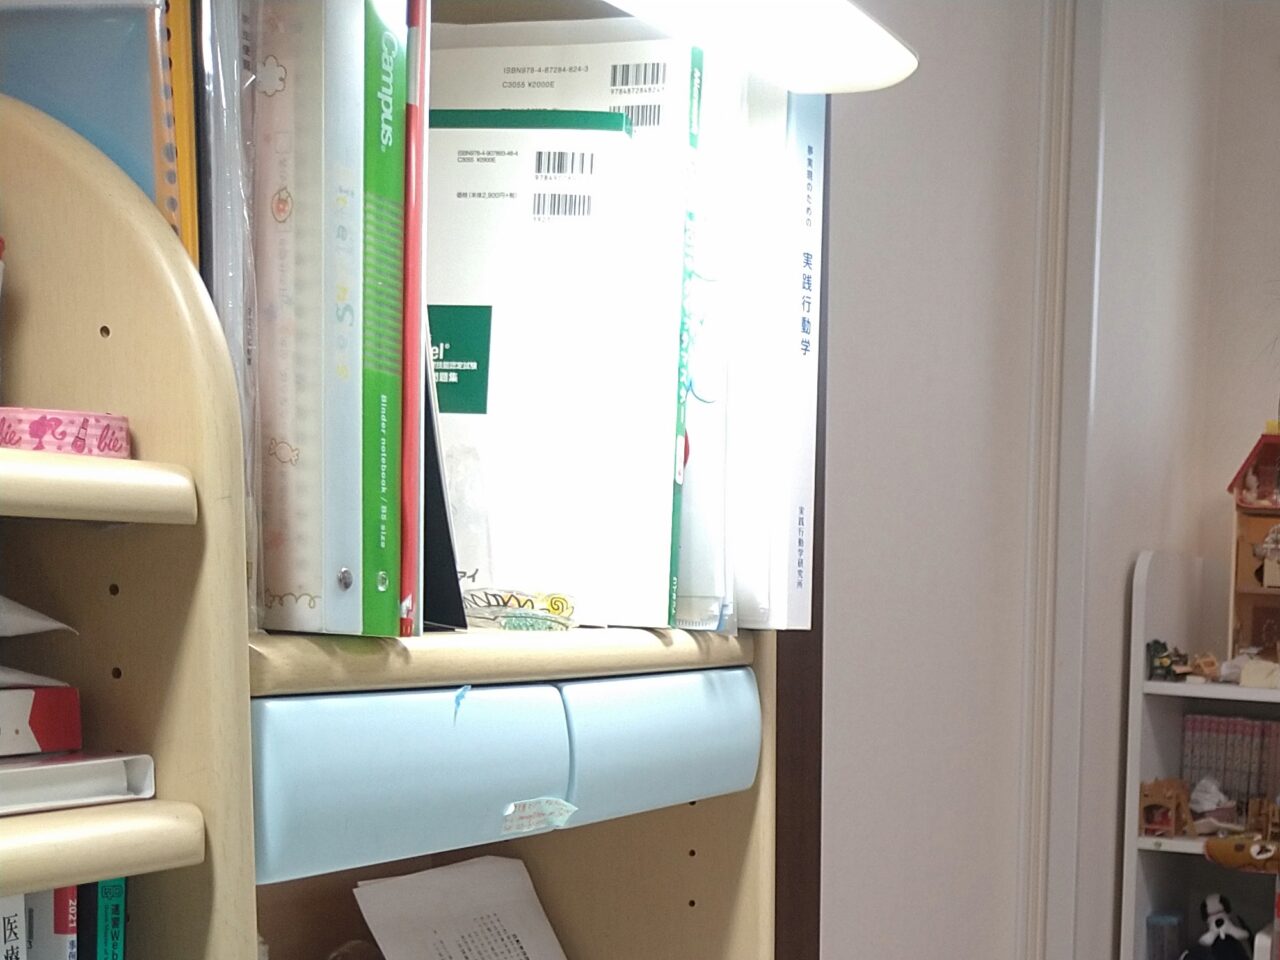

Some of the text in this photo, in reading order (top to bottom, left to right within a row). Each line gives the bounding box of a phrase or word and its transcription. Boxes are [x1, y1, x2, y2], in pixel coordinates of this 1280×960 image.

[378, 31, 398, 146] Campus
[800, 252, 813, 356] 実践行動学
[379, 394, 388, 434] Binder
[379, 437, 388, 493] notebook
[68, 899, 77, 928] 2021
